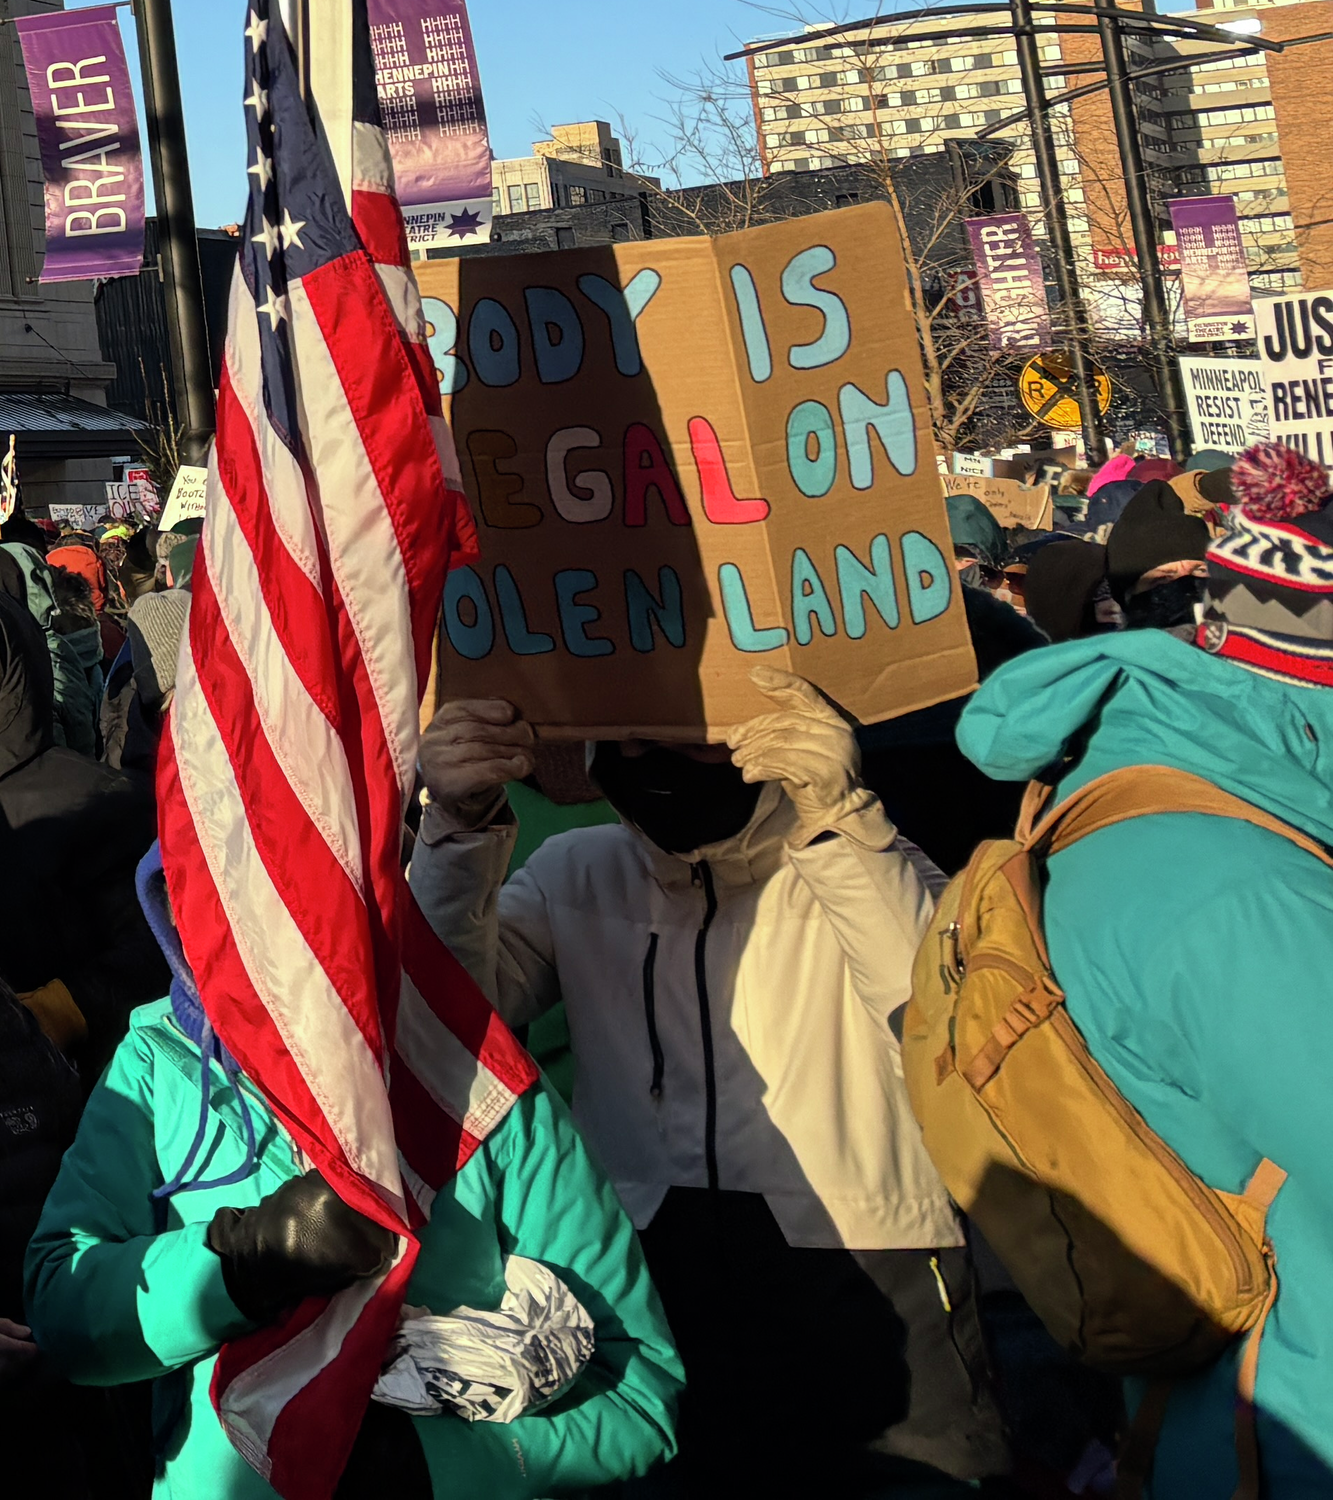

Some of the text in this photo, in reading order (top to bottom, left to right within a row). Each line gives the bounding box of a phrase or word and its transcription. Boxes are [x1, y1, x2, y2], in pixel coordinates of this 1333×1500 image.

[377, 81, 415, 99] ARTS
[46, 55, 127, 238] BRAVER
[403, 212, 446, 226] NNEPIN
[409, 223, 439, 235] ATRE
[410, 233, 437, 243] RICT
[980, 222, 1041, 347] BRIGHTER
[419, 244, 851, 396] BODY IS
[1027, 381, 1046, 398] R
[1189, 367, 1267, 394] MINNEAPOL
[1195, 394, 1243, 420] RESIST
[1200, 420, 1247, 447] DEFEND
[465, 368, 918, 530] EGAL ON
[107, 483, 141, 500] ICE
[439, 530, 952, 660] OLEN LAND
